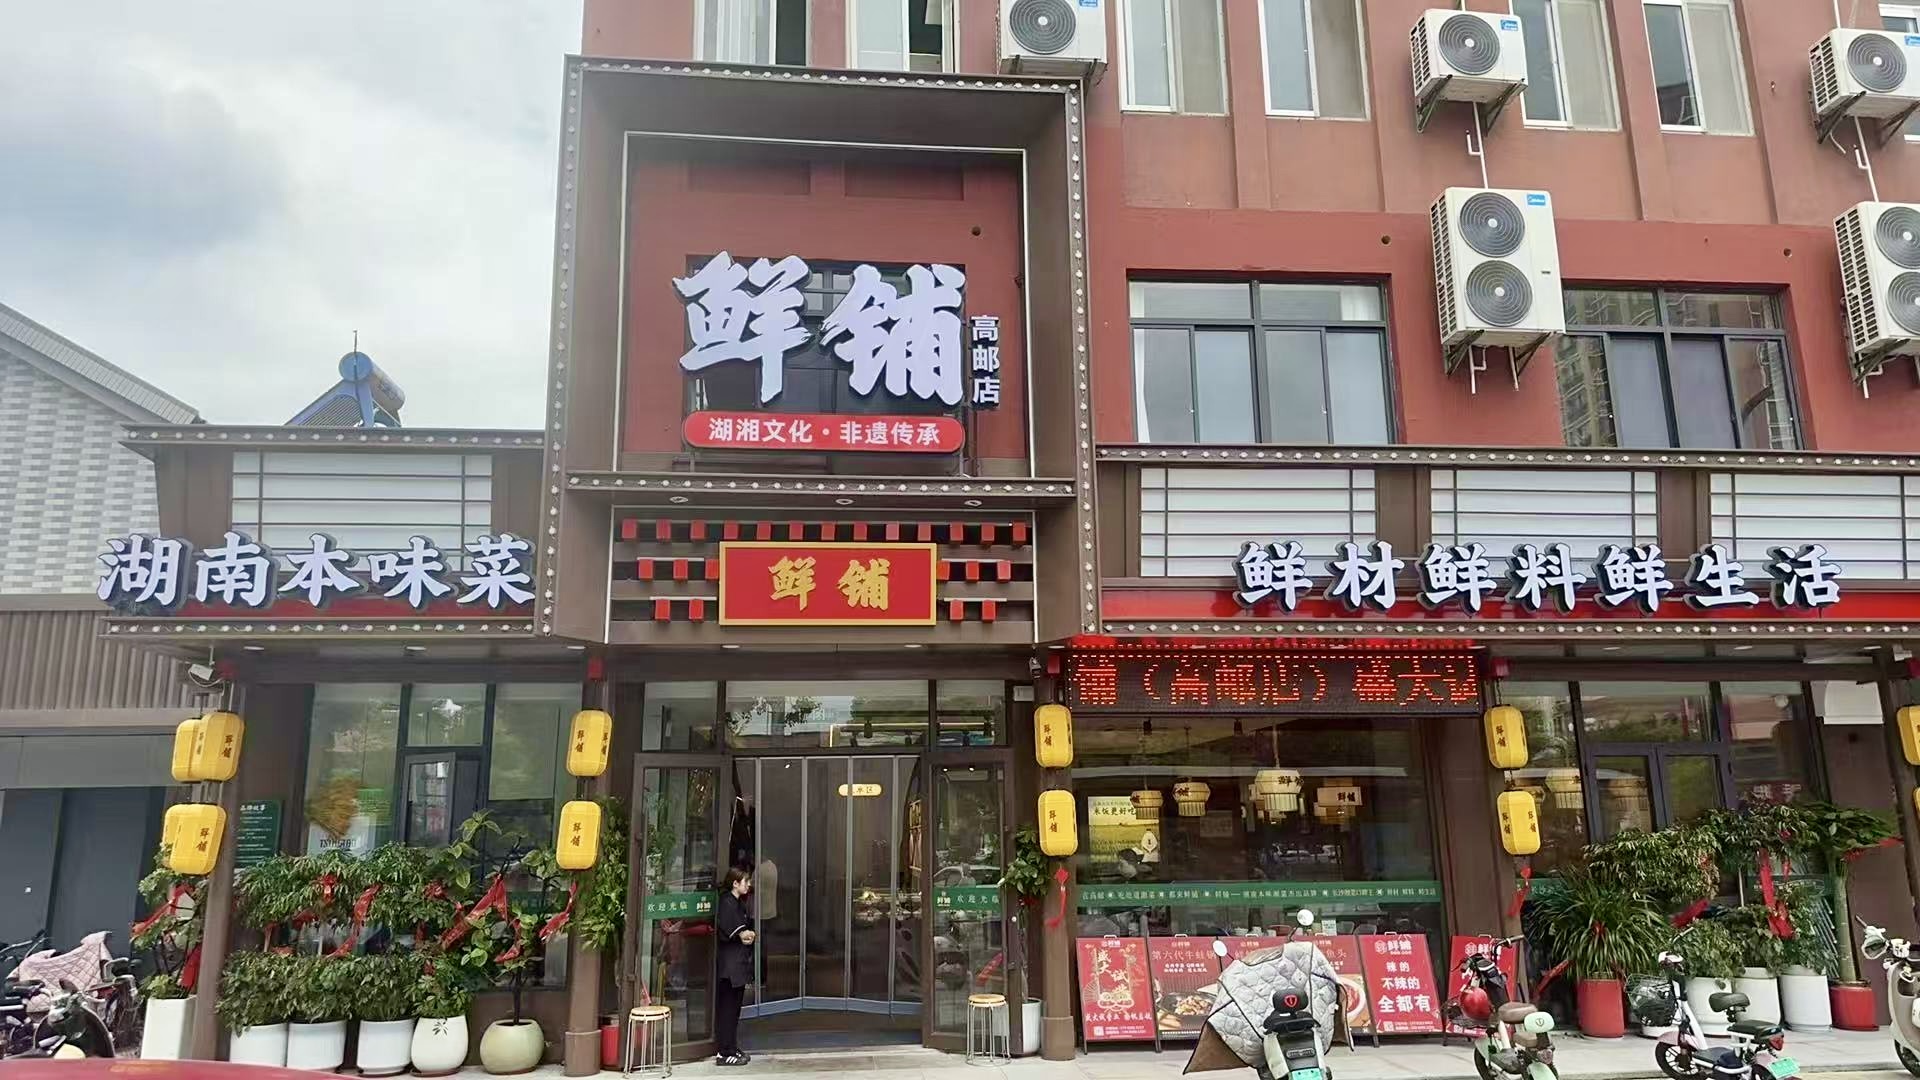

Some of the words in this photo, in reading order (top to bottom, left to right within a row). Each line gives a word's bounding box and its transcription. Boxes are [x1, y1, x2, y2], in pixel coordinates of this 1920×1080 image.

[672, 250, 966, 405] 鲜铺
[971, 315, 1000, 404] 高邮店
[708, 417, 940, 446] 湖湘文化·非遗传承
[97, 531, 536, 609] 湖南本味菜
[768, 556, 891, 612] 鲜铺
[1237, 540, 1842, 612] 鲜材鲜料鲜生活
[1378, 994, 1431, 1013] 全都有
[1381, 976, 1421, 990] 不辣的
